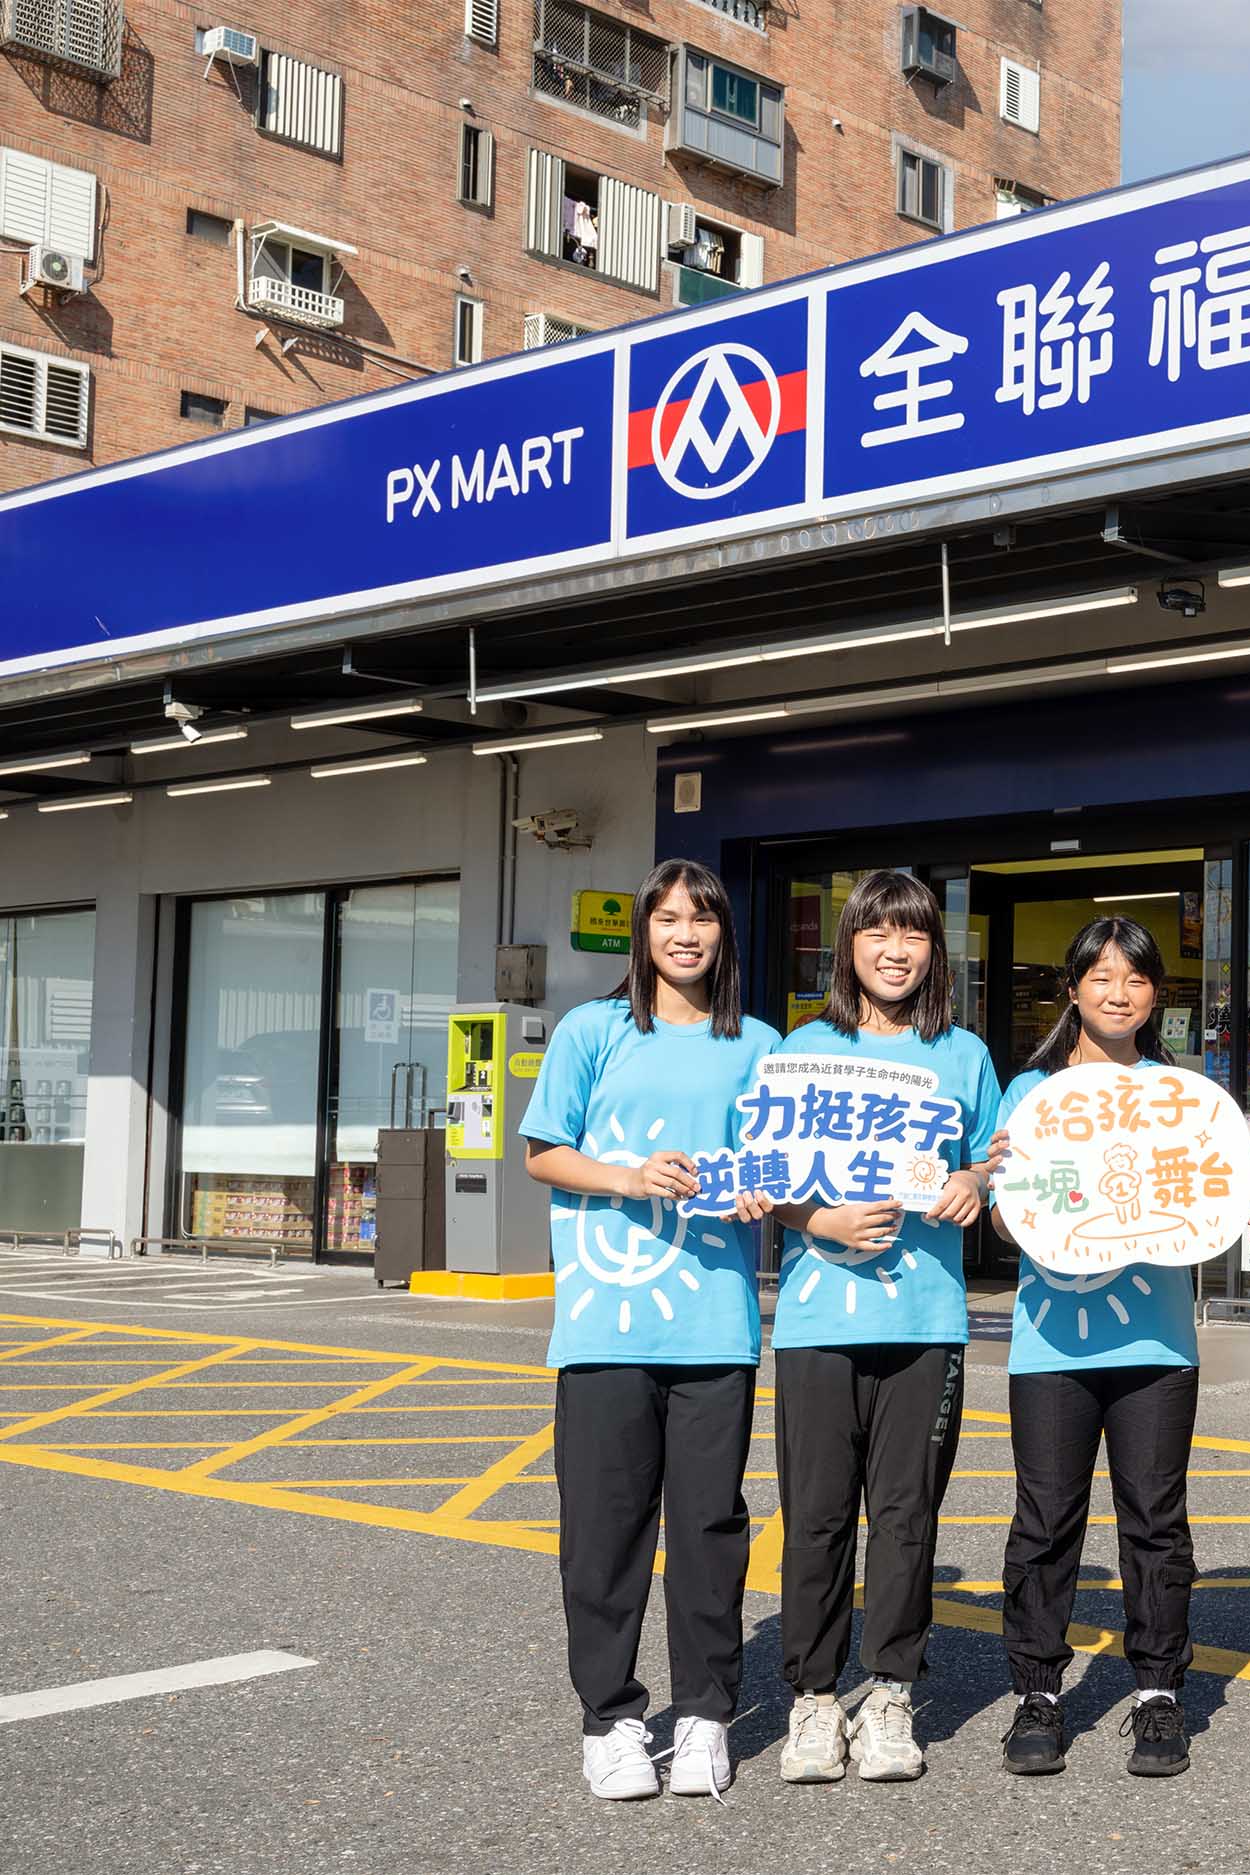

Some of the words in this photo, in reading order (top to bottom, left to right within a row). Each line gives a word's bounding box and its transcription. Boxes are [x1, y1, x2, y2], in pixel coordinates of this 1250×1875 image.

[386, 459, 442, 523] PX
[451, 427, 584, 509] MART
[602, 938, 621, 948] ATM
[763, 1062, 933, 1089] 邀請您成為近貧學子生命中的陽光
[742, 1083, 959, 1150] 力挺孩子
[1034, 1075, 1201, 1141] 給孩子
[683, 1149, 895, 1213] 逆轉人生
[1003, 1160, 1090, 1214] 一塊
[1146, 1146, 1233, 1208] 舞台
[931, 1350, 963, 1446] TARGET
